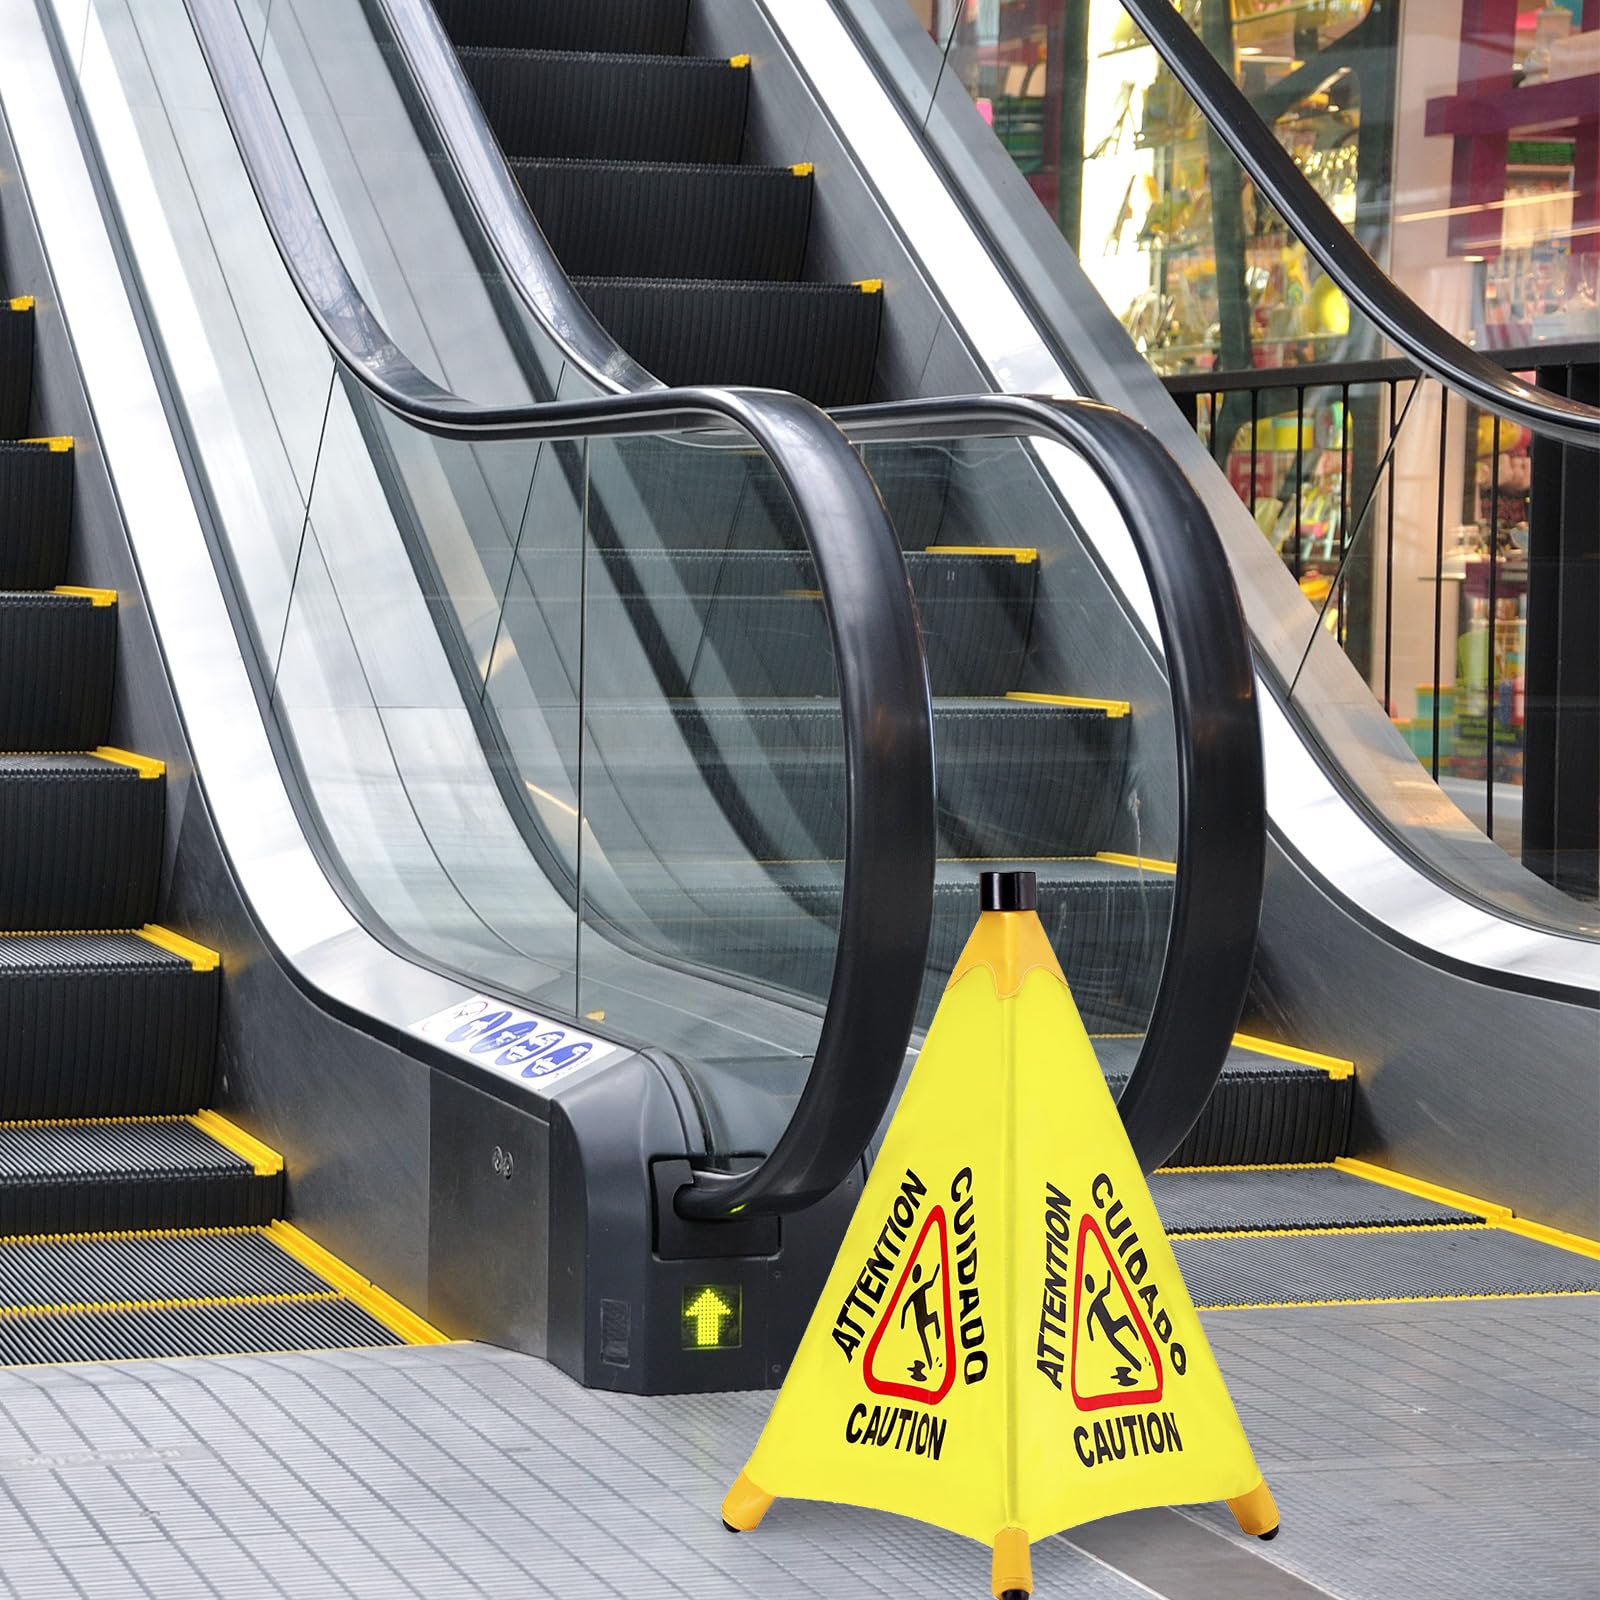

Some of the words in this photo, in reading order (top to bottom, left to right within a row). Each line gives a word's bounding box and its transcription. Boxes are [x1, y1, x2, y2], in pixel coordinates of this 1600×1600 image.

[831, 1168, 928, 1364] ATTENTION
[950, 1166, 989, 1385] CUIDADO
[1036, 1181, 1072, 1391] ATTENTION
[1091, 1173, 1188, 1376] CUIDADO
[845, 1402, 947, 1461] CAUTION
[1073, 1411, 1183, 1468] CAUTION
